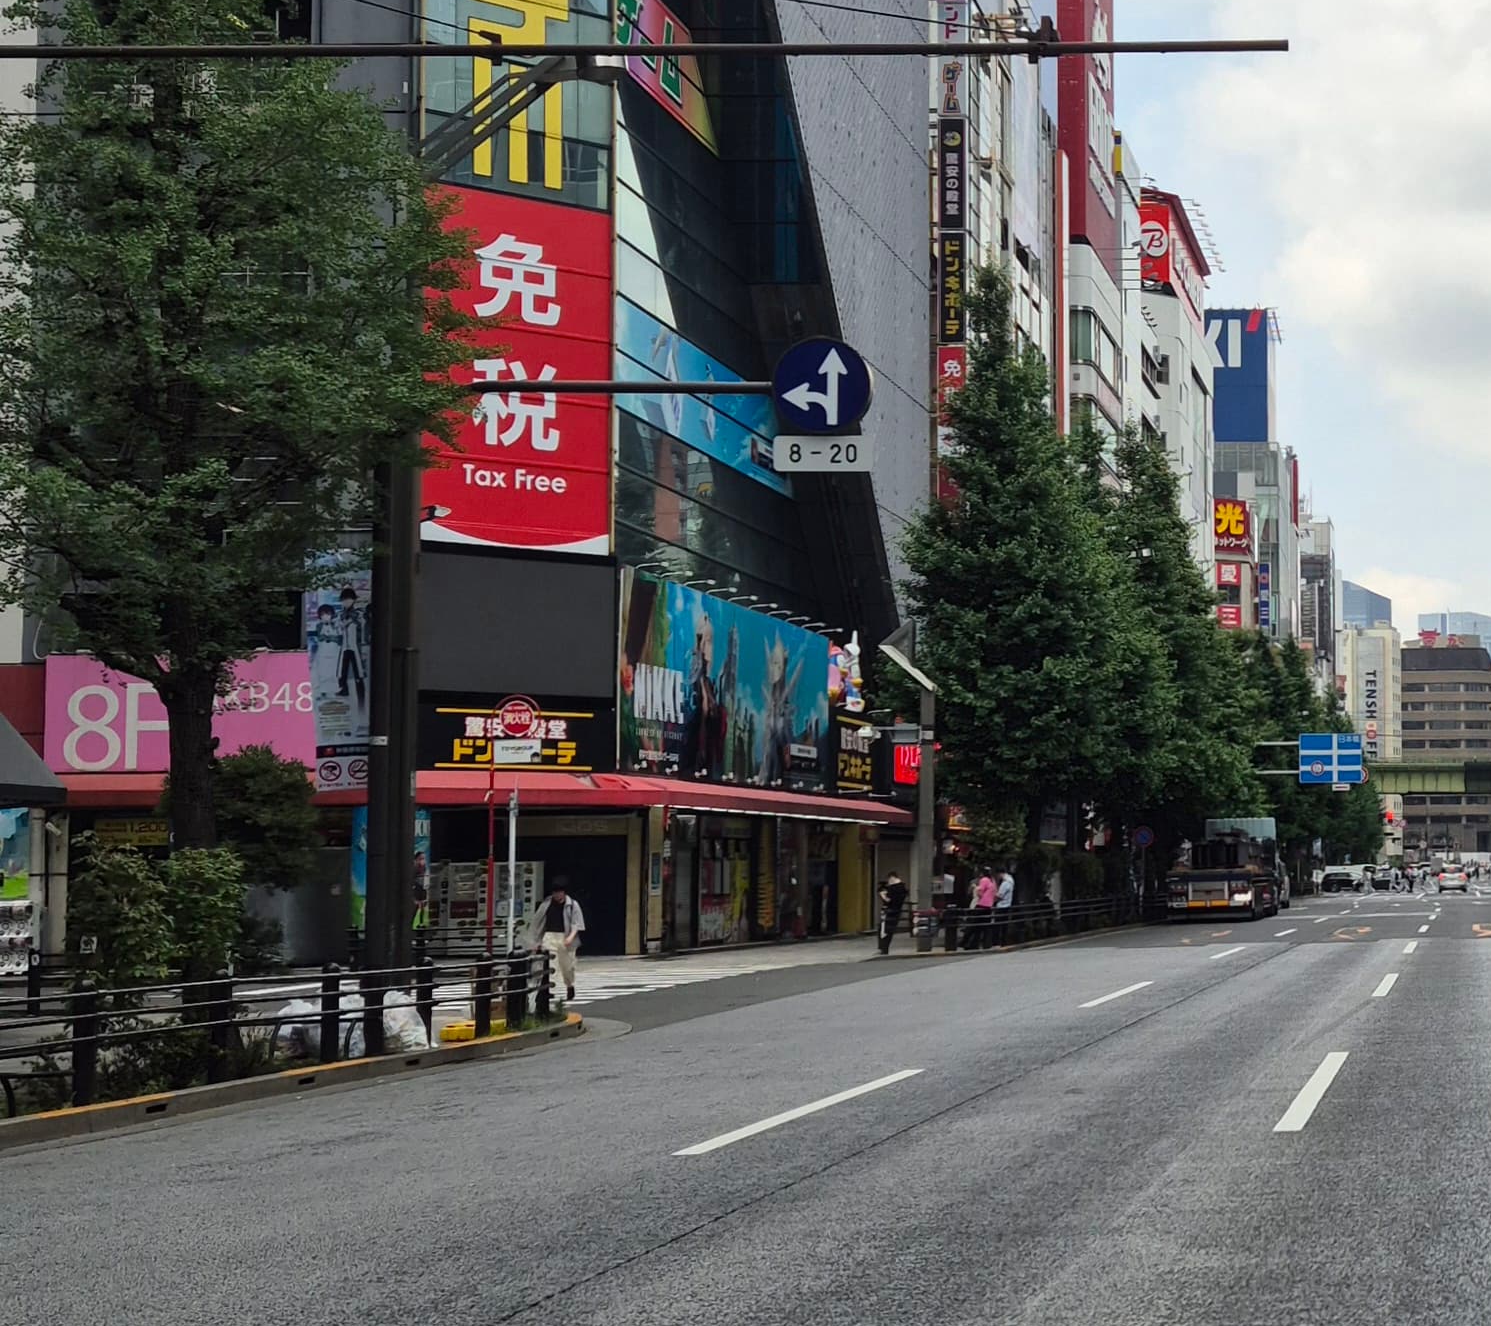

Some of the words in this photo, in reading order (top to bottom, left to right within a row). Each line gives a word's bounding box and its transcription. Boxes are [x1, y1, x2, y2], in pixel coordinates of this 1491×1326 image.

[473, 233, 562, 451] 免税
[462, 464, 507, 488] Tax
[515, 469, 568, 493] Free
[213, 681, 314, 713] KB48
